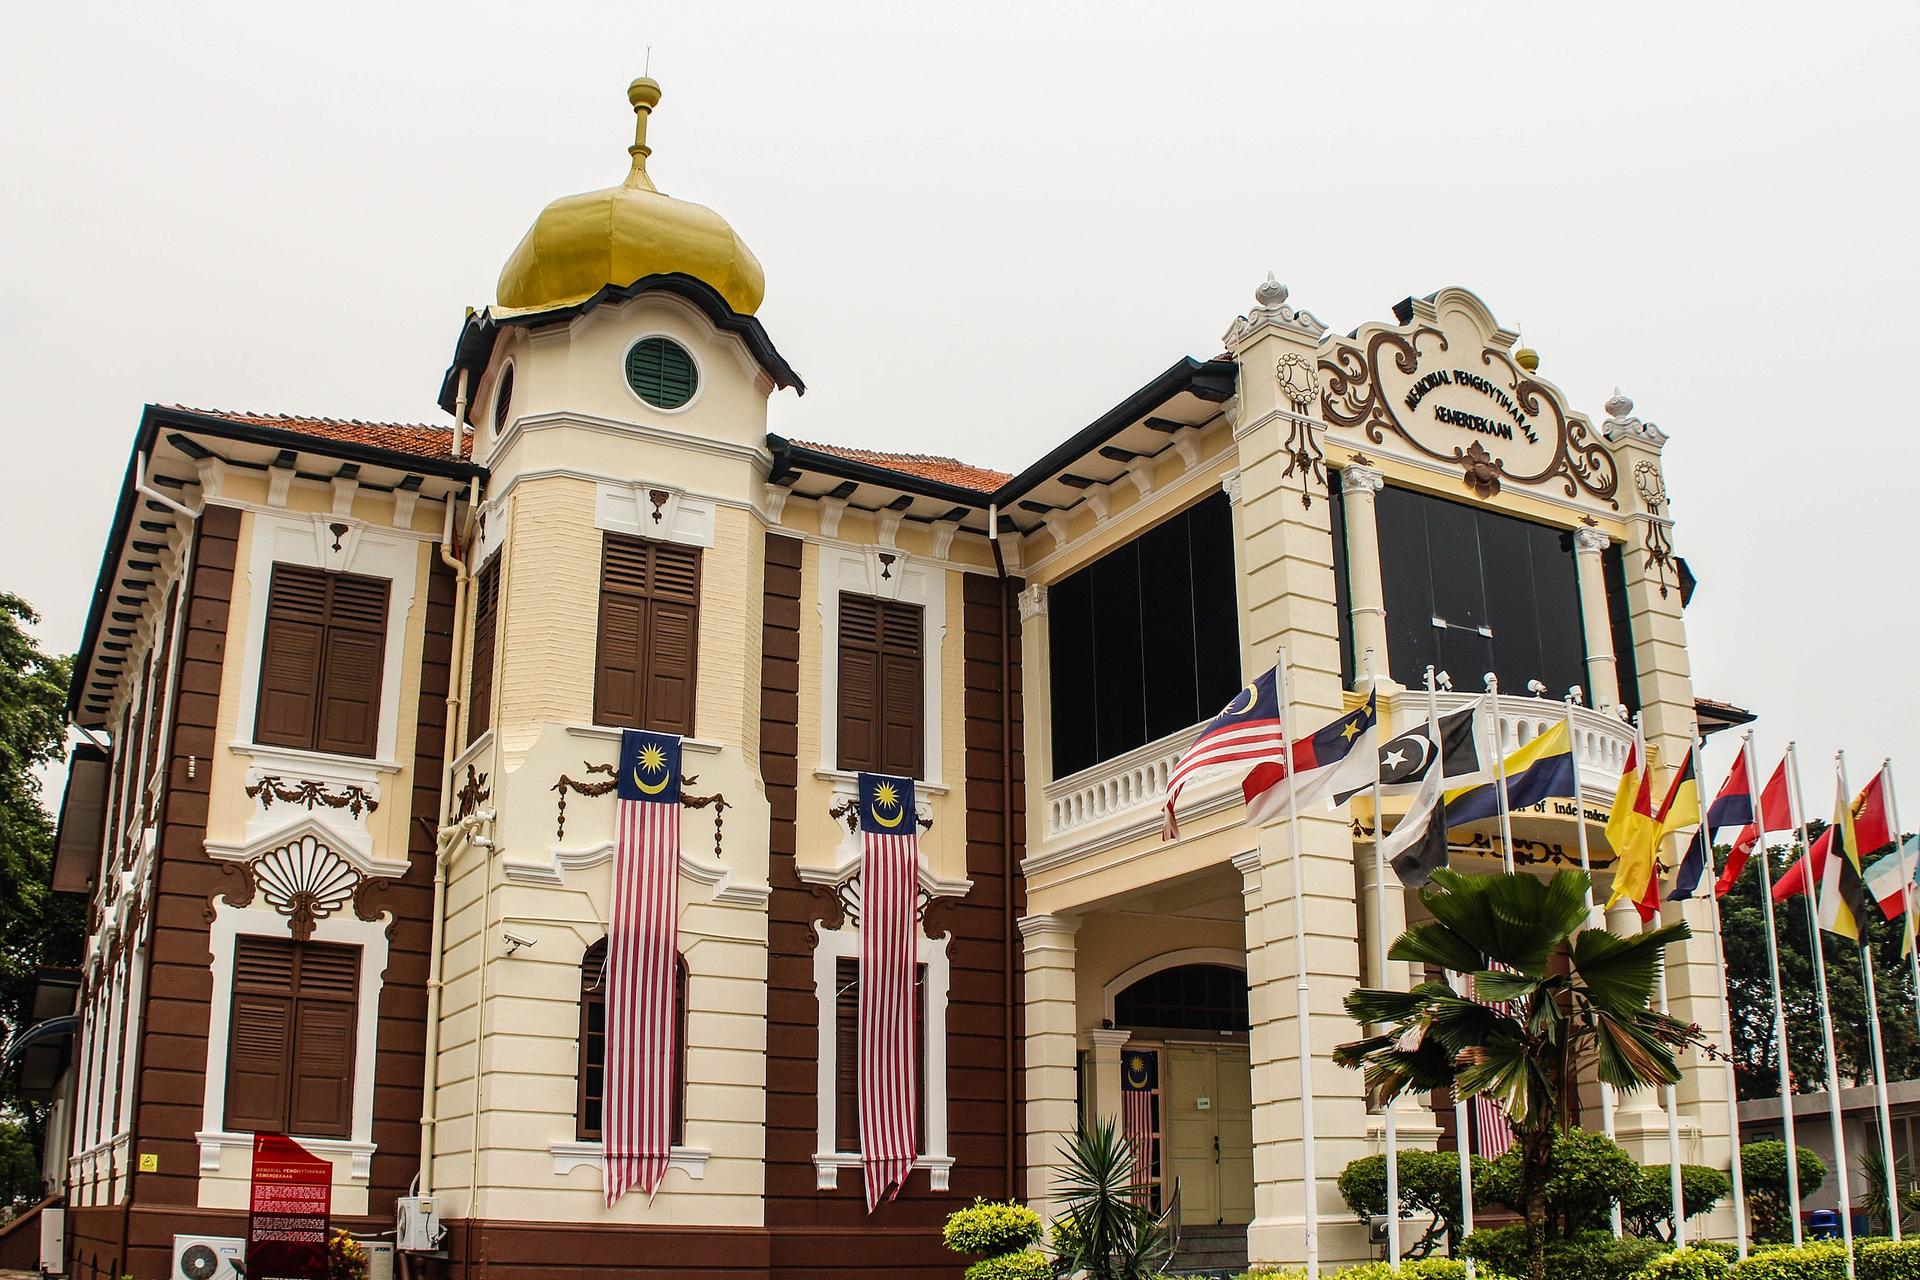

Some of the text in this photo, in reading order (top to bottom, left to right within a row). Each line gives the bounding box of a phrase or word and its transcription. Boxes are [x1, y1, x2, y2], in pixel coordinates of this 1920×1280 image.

[1404, 369, 1539, 444] MEMORIAL PENGISYTIHARAN
[1434, 404, 1513, 440] KEMERDEKAAN
[1534, 800, 1610, 823] of Indeendenc
